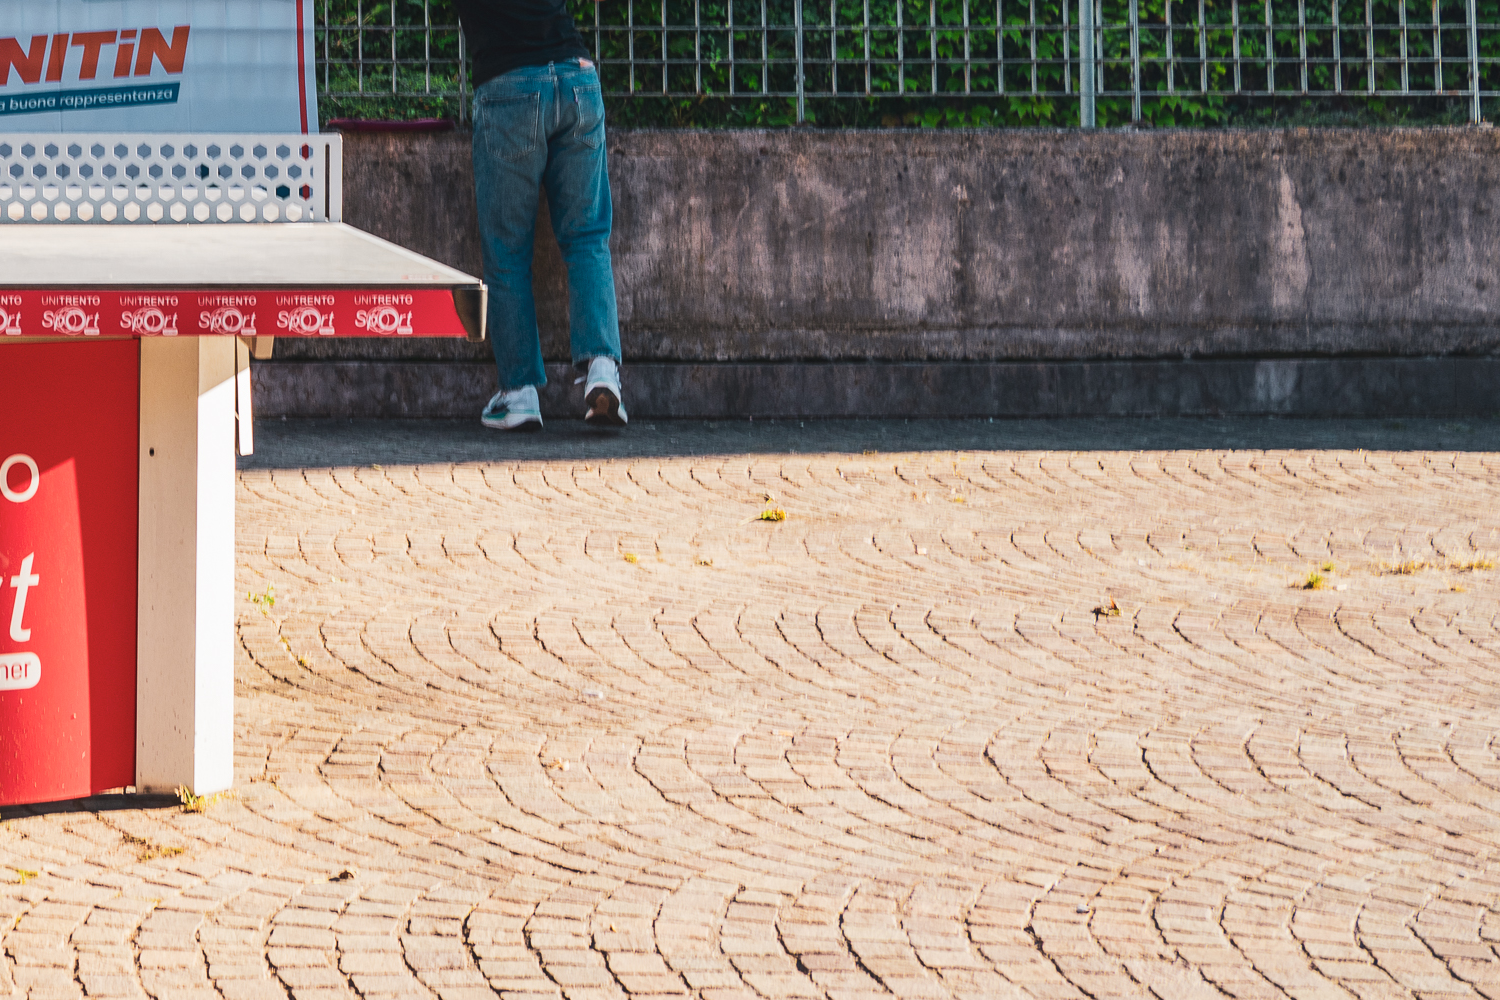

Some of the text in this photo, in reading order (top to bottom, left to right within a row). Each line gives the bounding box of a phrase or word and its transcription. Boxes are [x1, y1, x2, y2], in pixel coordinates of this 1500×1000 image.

[10, 96, 56, 111] buona
[59, 88, 173, 109] rappresentanza
[41, 294, 101, 306] UNITRENTO
[119, 294, 179, 306] UNITRENTO
[197, 294, 257, 306] UNITRENTO
[275, 294, 335, 306] UNITRENTO
[354, 294, 414, 306] UNITRENTO
